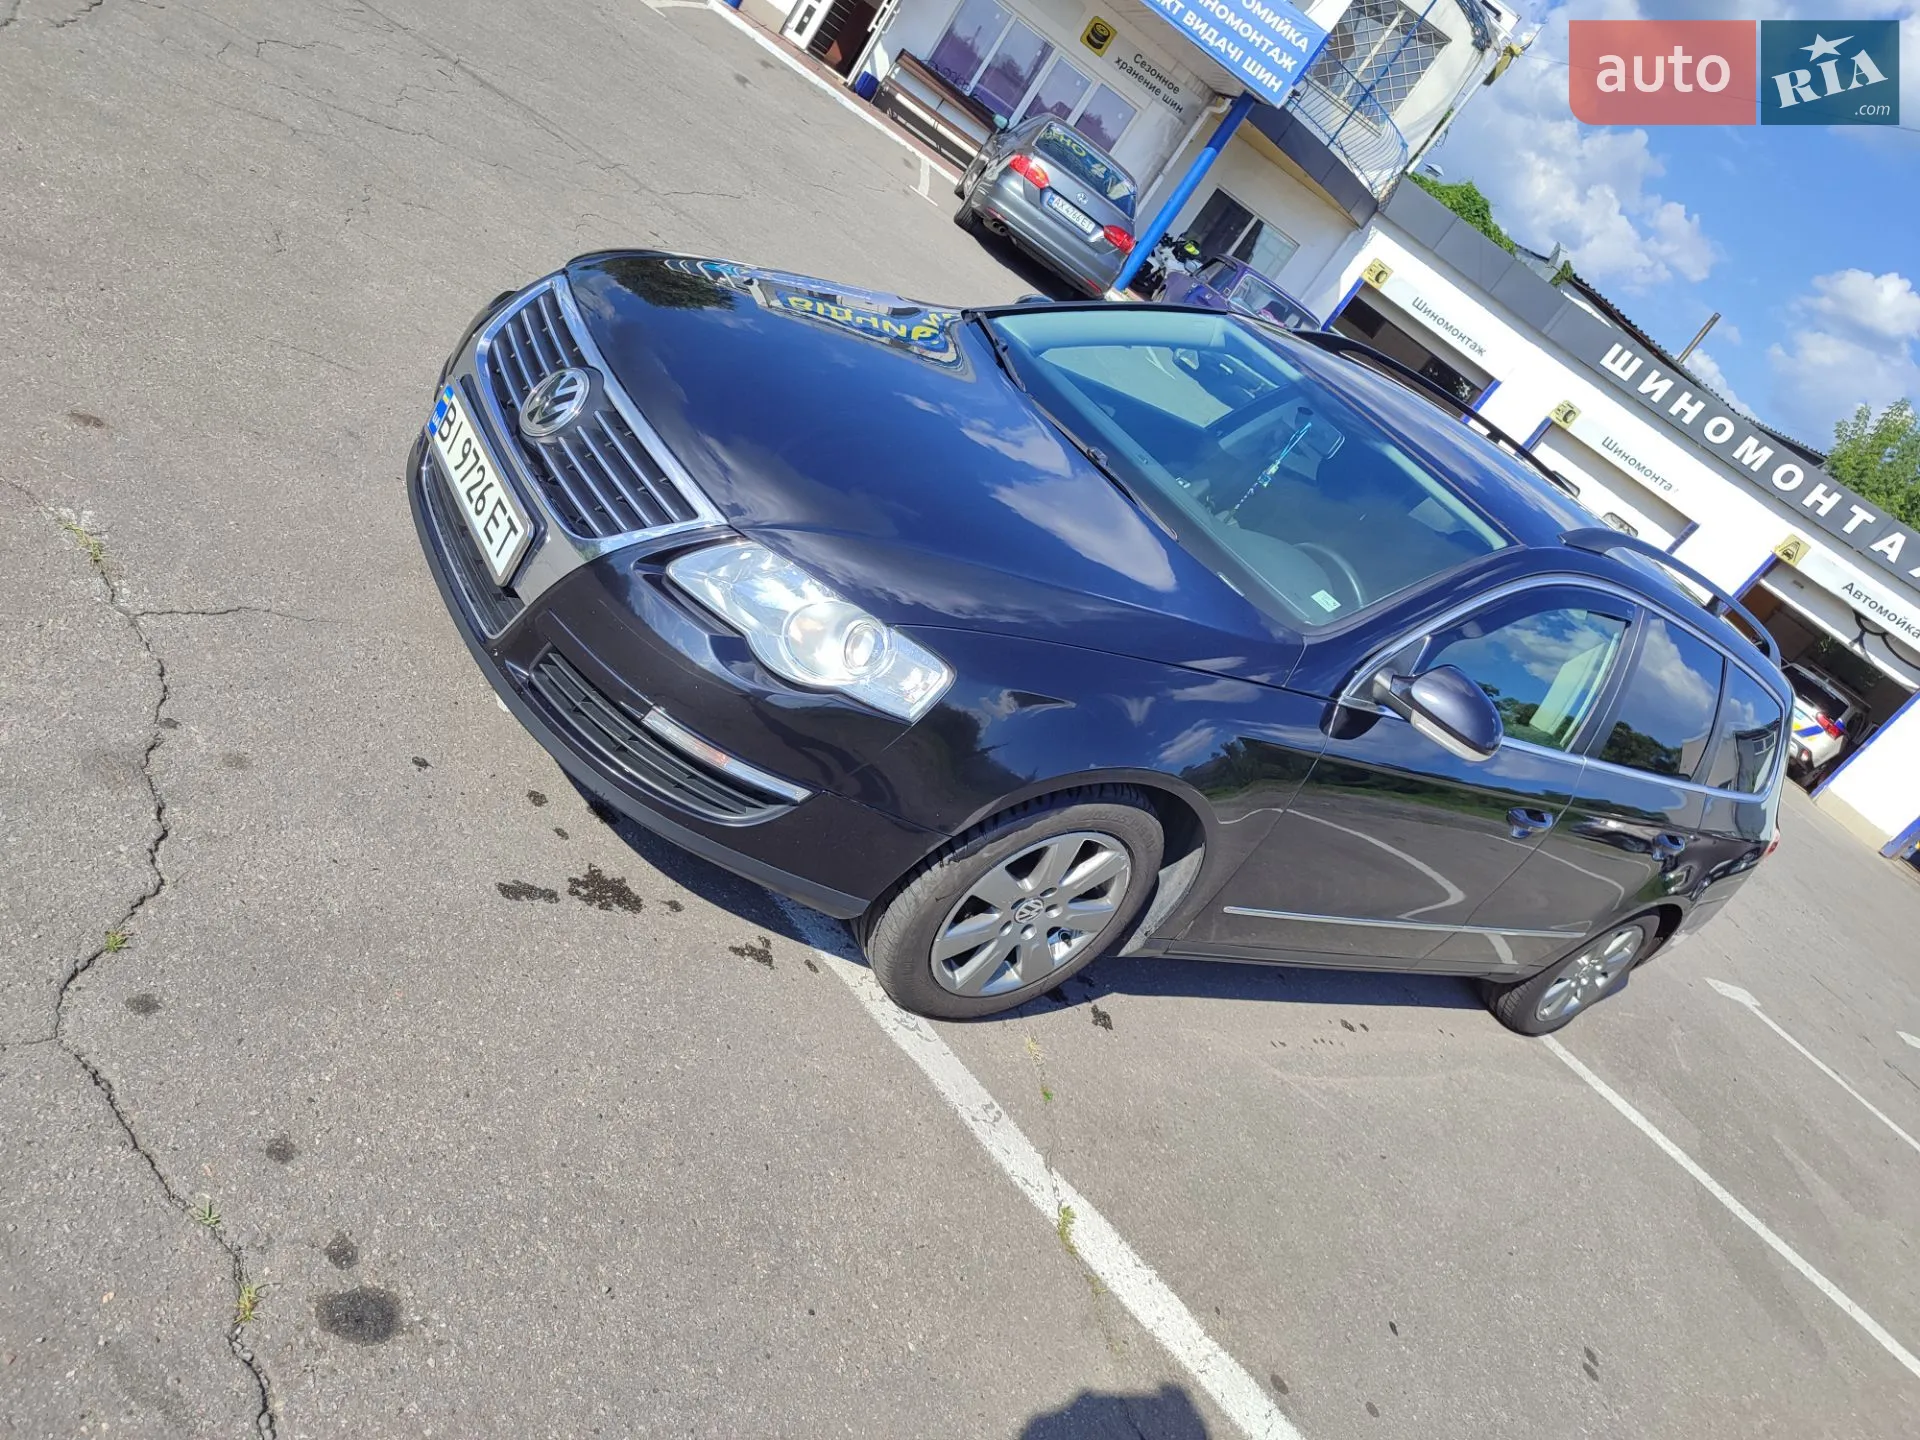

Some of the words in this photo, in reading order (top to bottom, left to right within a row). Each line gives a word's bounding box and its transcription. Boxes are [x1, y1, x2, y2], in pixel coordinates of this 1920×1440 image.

[1133, 53, 1180, 95] Сезонное
[1182, 10, 1244, 61] ВИДАЧІ
[1242, 56, 1283, 94] ШИН
[1114, 56, 1161, 97] хранение
[1161, 94, 1184, 114] шин
[1411, 296, 1487, 357] Шиномонтаж
[438, 404, 463, 454] BI
[454, 438, 494, 516] 9726
[484, 497, 519, 558] ET
[1599, 342, 1920, 578] ШИНОМОНТА
[1601, 436, 1679, 494] Шиномонта
[1840, 580, 1920, 640] Автомойка
